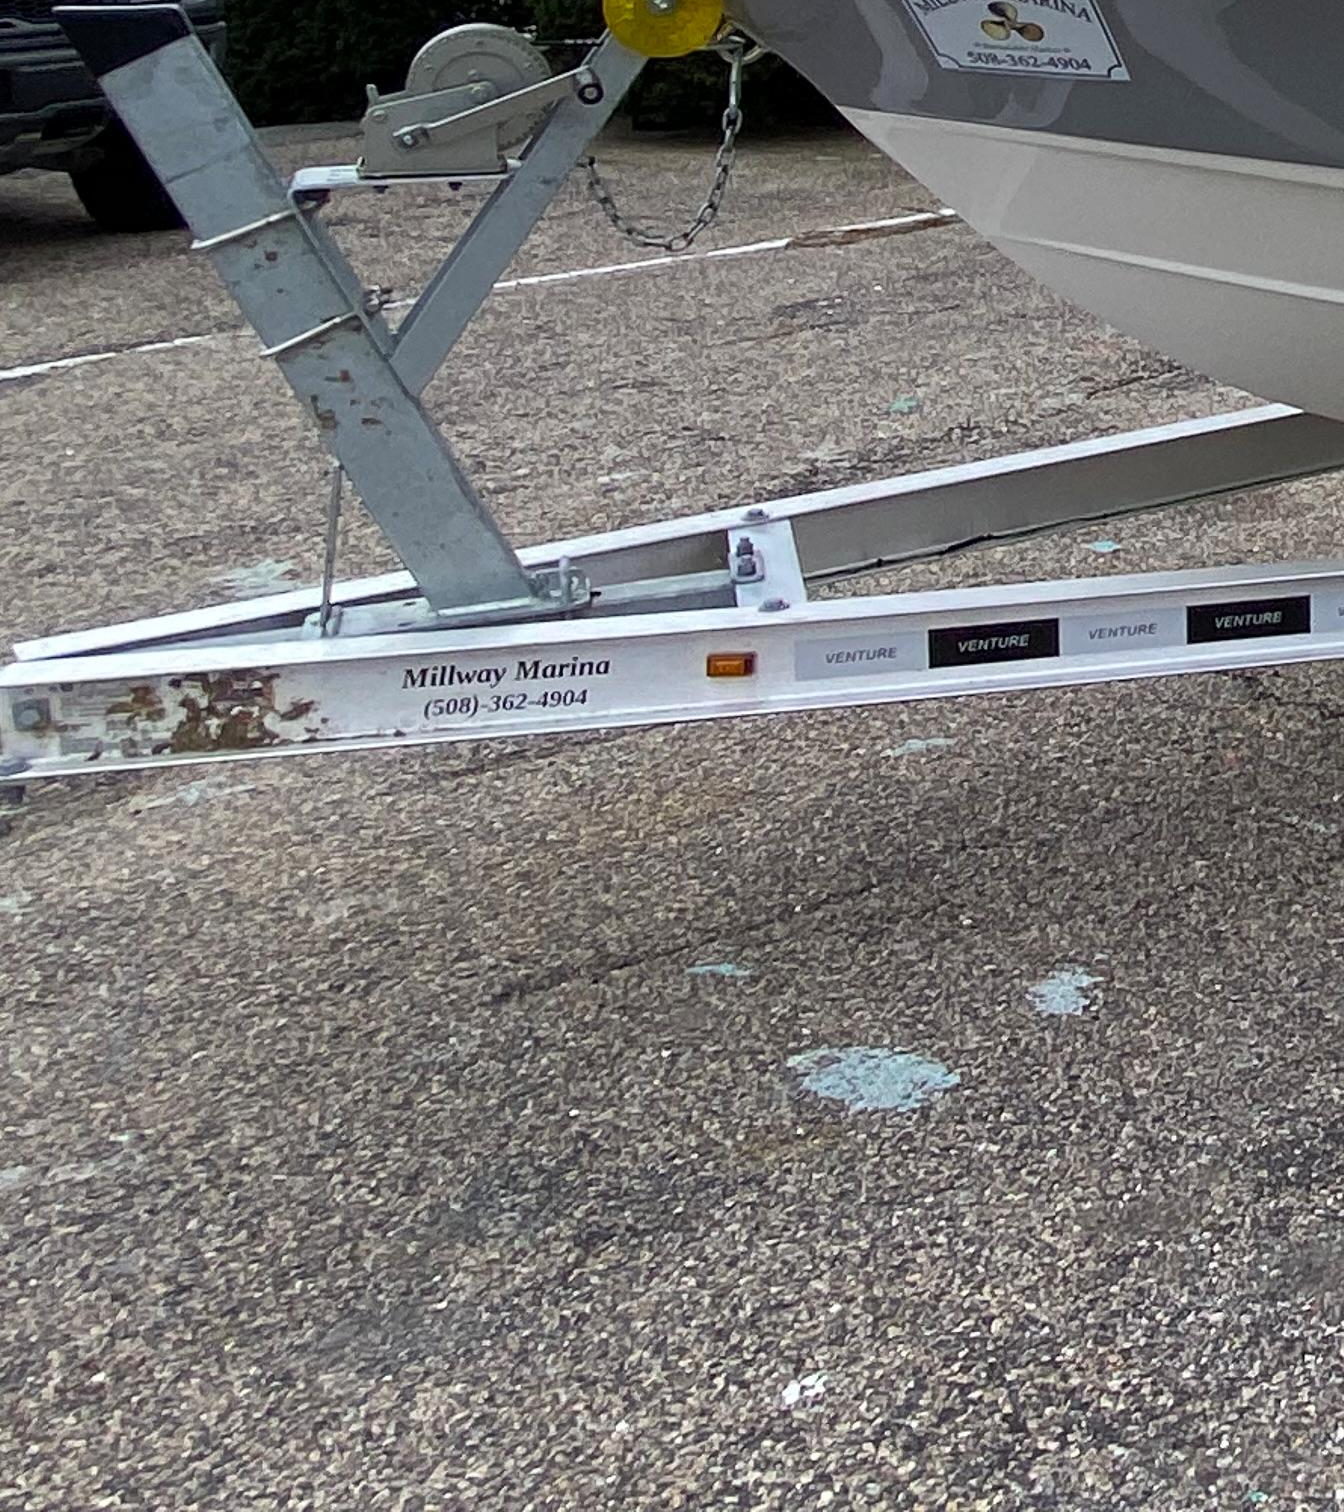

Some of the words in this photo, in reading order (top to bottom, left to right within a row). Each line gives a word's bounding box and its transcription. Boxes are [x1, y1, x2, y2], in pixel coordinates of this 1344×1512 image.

[967, 50, 1092, 71] 508-362-4904
[1214, 610, 1283, 629] VENTURE
[1088, 623, 1158, 641] VENTURE
[957, 633, 1029, 653] VENTURE
[825, 646, 897, 665] VENTURE
[402, 664, 507, 689] Millway
[514, 656, 611, 681] Marina
[424, 689, 588, 720] (508)-362-4904
